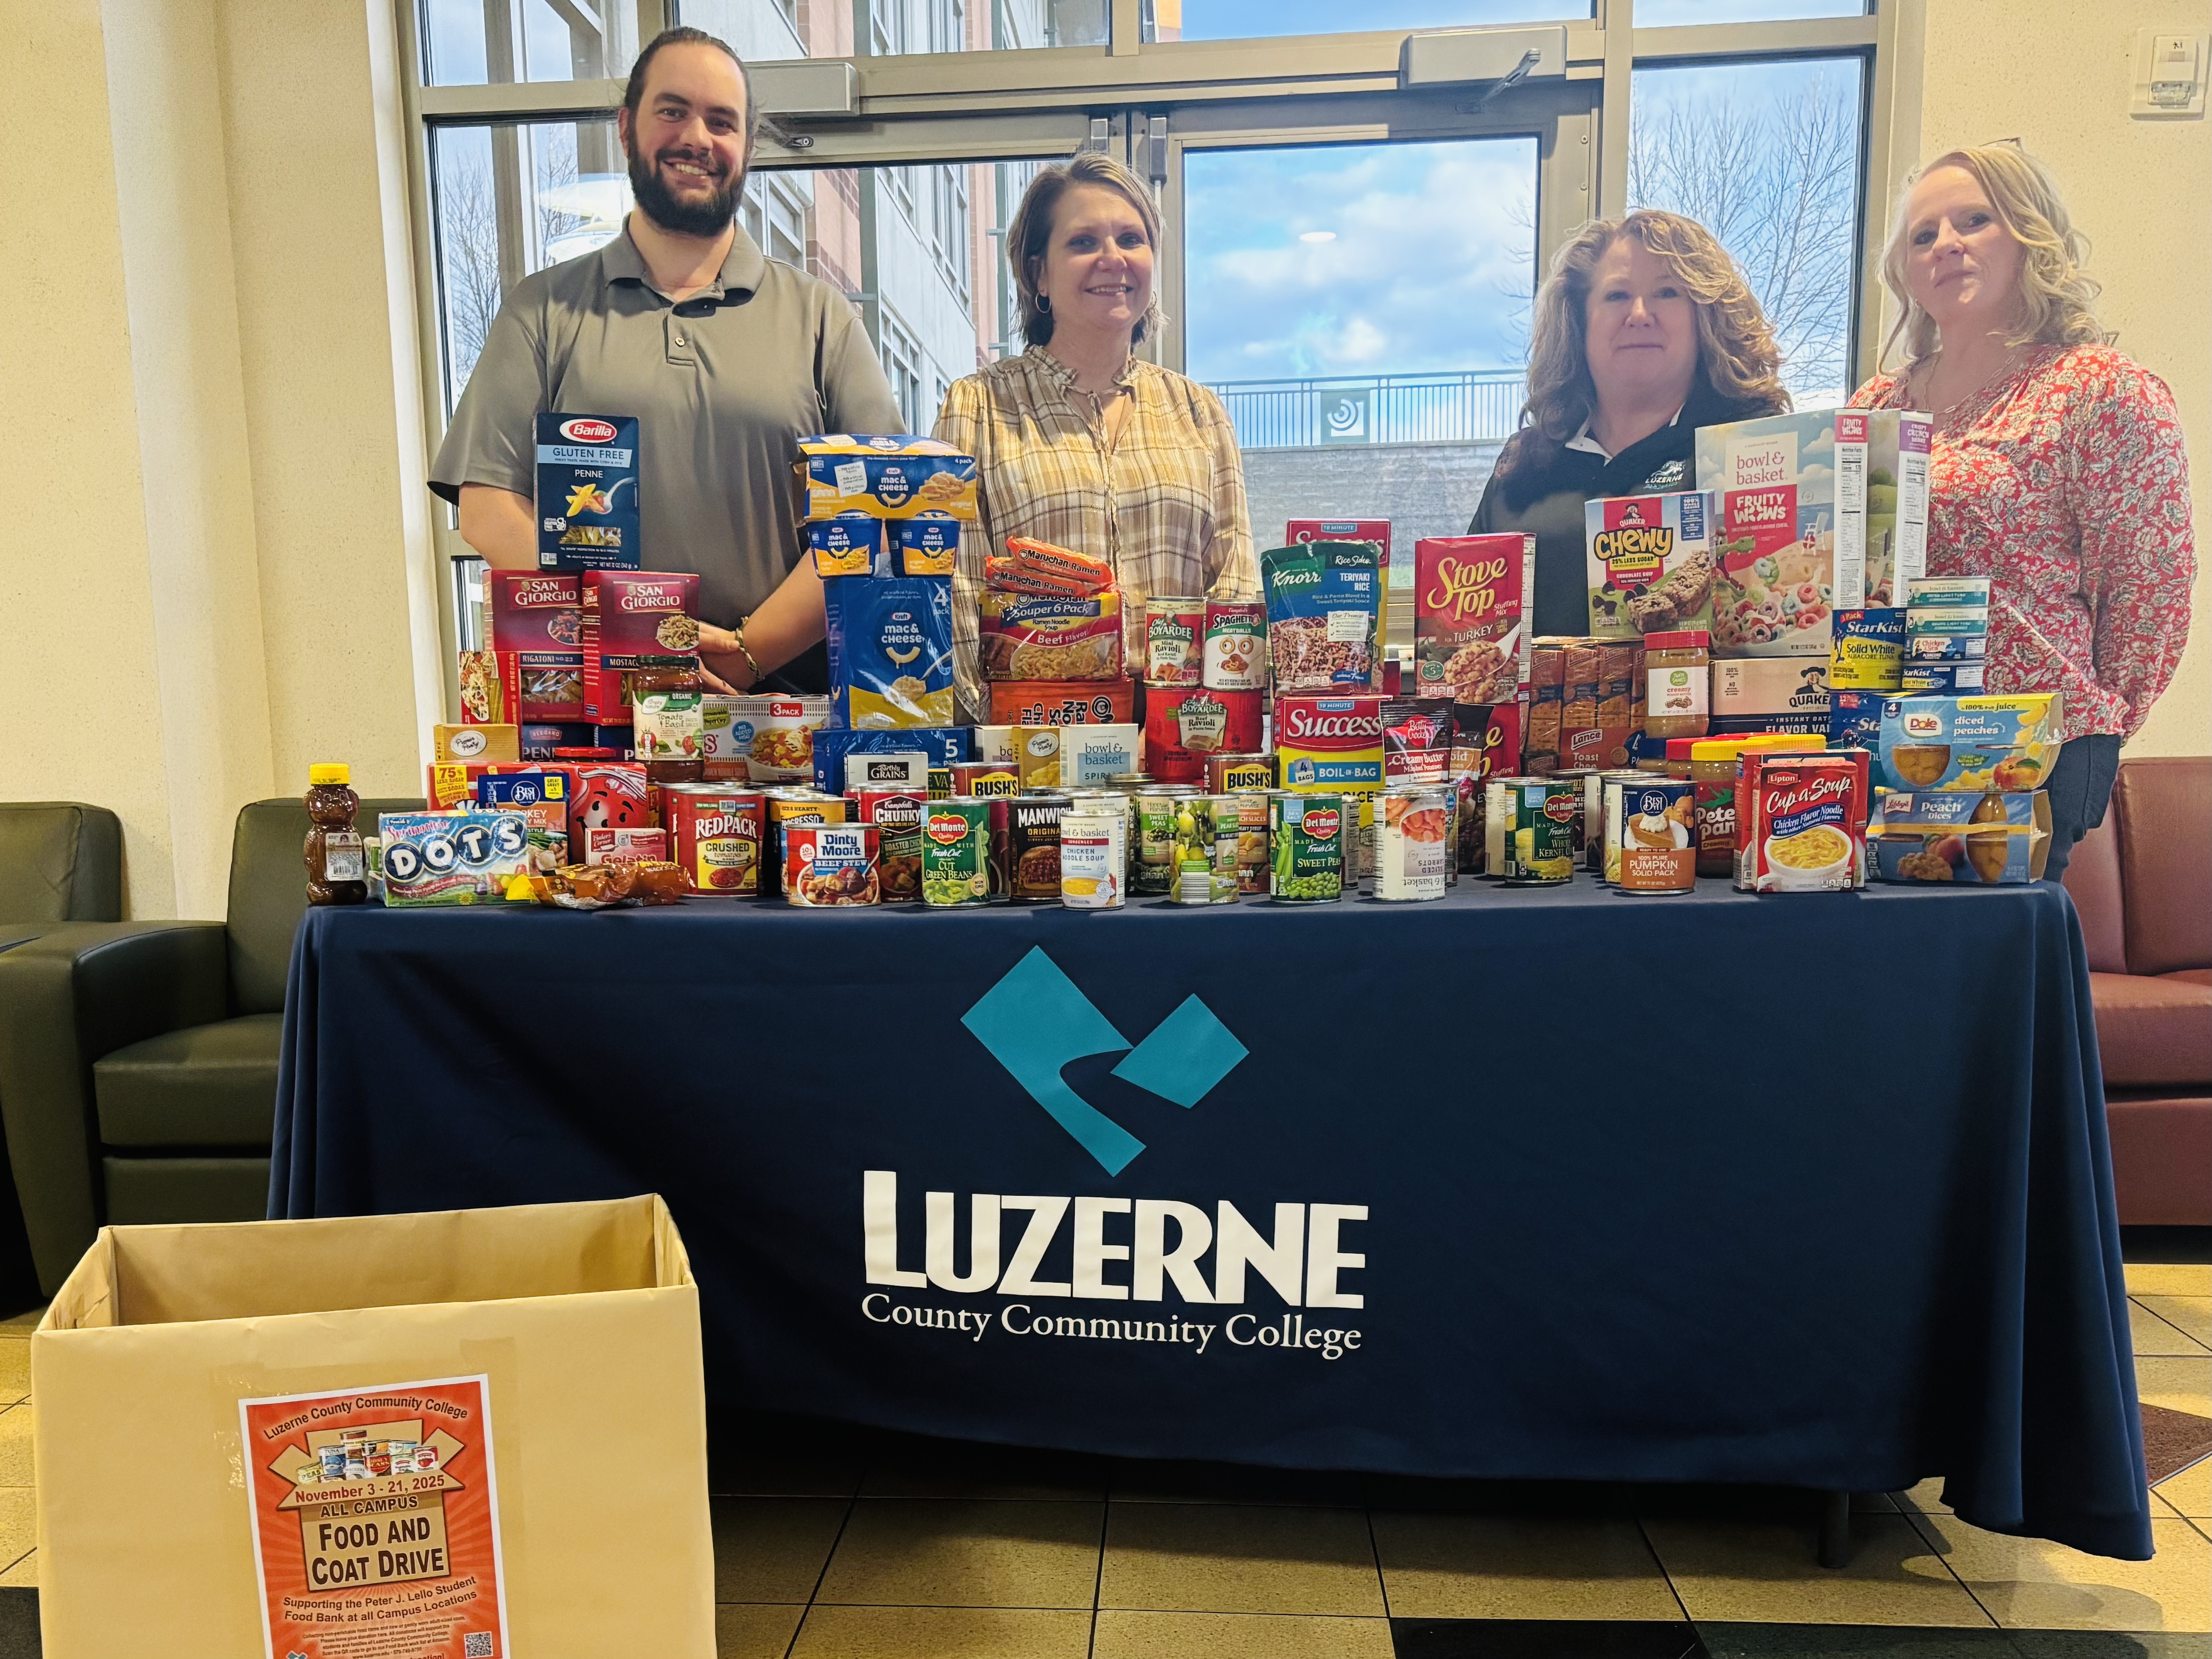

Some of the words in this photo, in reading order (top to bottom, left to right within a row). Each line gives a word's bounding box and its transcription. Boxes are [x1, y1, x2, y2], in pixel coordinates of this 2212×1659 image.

[573, 424, 612, 436] Barilla
[553, 448, 594, 458] GLUTEN
[600, 450, 624, 459] FREE
[1736, 452, 1769, 469] bowl
[1772, 452, 1784, 465] &
[1645, 473, 1684, 484] LUZERNE
[1736, 468, 1784, 485] basket
[1736, 493, 1786, 509] FRUITY
[1733, 506, 1786, 525] WOWS
[1620, 519, 1646, 527] QUAKER
[1027, 550, 1069, 567] Maruchan
[1071, 563, 1101, 575] Ramen
[1335, 555, 1351, 564] Rice
[1271, 570, 1322, 587] Knorr
[1339, 573, 1370, 581] TERIYAKI
[529, 581, 559, 592] SAN
[1000, 573, 1041, 587] Maruchan
[1044, 582, 1074, 594] Ramen
[1354, 583, 1370, 591] RICE
[1427, 557, 1508, 609] Stove
[637, 586, 663, 596] SAN
[515, 590, 576, 605] GIORGIO
[621, 595, 680, 610] GIORGIO
[934, 588, 949, 606] 4
[1053, 604, 1061, 612] 6
[1063, 604, 1089, 614] Pack
[1453, 588, 1495, 621] Top
[1493, 599, 1518, 611] Stuffing
[1495, 609, 1507, 617] Mix
[885, 625, 909, 633] mac
[911, 623, 919, 633] &
[1149, 626, 1192, 639] BOYARDEE
[1846, 622, 1903, 633] StarKist
[1453, 624, 1493, 643] TURKEY
[1037, 635, 1063, 644] Beef
[1847, 644, 1867, 654] Solid
[1870, 644, 1895, 654] White
[1182, 703, 1224, 714] BOYARDEE
[1888, 703, 1897, 711] 4
[1287, 709, 1381, 737] Success
[1409, 720, 1427, 731] Betty
[1910, 718, 1938, 728] Dole
[1955, 716, 1984, 725] diced
[1954, 726, 1999, 736] peaches
[1573, 731, 1601, 746] Lance
[945, 739, 958, 758] 5
[1085, 743, 1112, 753] bowl
[1113, 744, 1122, 753] &
[1085, 754, 1122, 765] basket
[1300, 762, 1307, 772] 4
[871, 769, 906, 779] GRAINS
[1228, 773, 1270, 789] BUSH'S
[975, 780, 1017, 796] BUSH'S
[1547, 803, 1559, 812] Del
[1921, 802, 1961, 813] Peach
[876, 810, 921, 823] CHUNKY
[1774, 818, 1799, 830] Chicken
[1800, 811, 1820, 823] Flavor
[1820, 805, 1843, 816] Noodle
[1548, 827, 1564, 836] Fresh
[824, 834, 857, 846] Dinty
[391, 823, 521, 876] DOTS
[706, 843, 749, 852] CRUSHED
[821, 845, 861, 856] Moore
[931, 849, 947, 857] Fresh
[1307, 844, 1324, 853] Fresh
[601, 854, 657, 863] Gelatin
[1297, 858, 1326, 867] SWEET
[938, 861, 955, 870] CUT
[1630, 860, 1678, 869] PUMPKIN
[926, 869, 946, 879] GREEN
[948, 870, 973, 879] BEANS
[863, 1169, 1369, 1310] LUZERNE
[861, 1292, 993, 1342] County
[1000, 1304, 1217, 1354] Community
[1225, 1314, 1362, 1360] College
[263, 1413, 309, 1440] Luzerne
[311, 1400, 353, 1420] County
[355, 1396, 423, 1411] Community
[425, 1398, 468, 1419] College
[295, 1486, 363, 1503] November
[367, 1483, 375, 1495] 3
[413, 1476, 445, 1490] 2025
[320, 1504, 349, 1517] ALL
[354, 1496, 418, 1514] CAMPUS
[319, 1523, 379, 1551] FOOD
[388, 1517, 430, 1544] AND
[312, 1557, 369, 1585] COAT
[378, 1548, 444, 1578] DRIVE
[283, 1597, 342, 1611] Supporting
[345, 1599, 362, 1608] the
[365, 1596, 392, 1607] Peter
[395, 1594, 405, 1604] J.
[408, 1589, 433, 1602] Lello
[435, 1576, 477, 1595] Student
[284, 1611, 313, 1622] Food
[316, 1613, 344, 1622] Bank
[361, 1611, 373, 1621] all
[377, 1607, 422, 1620] Campus
[424, 1591, 477, 1612] Locations
